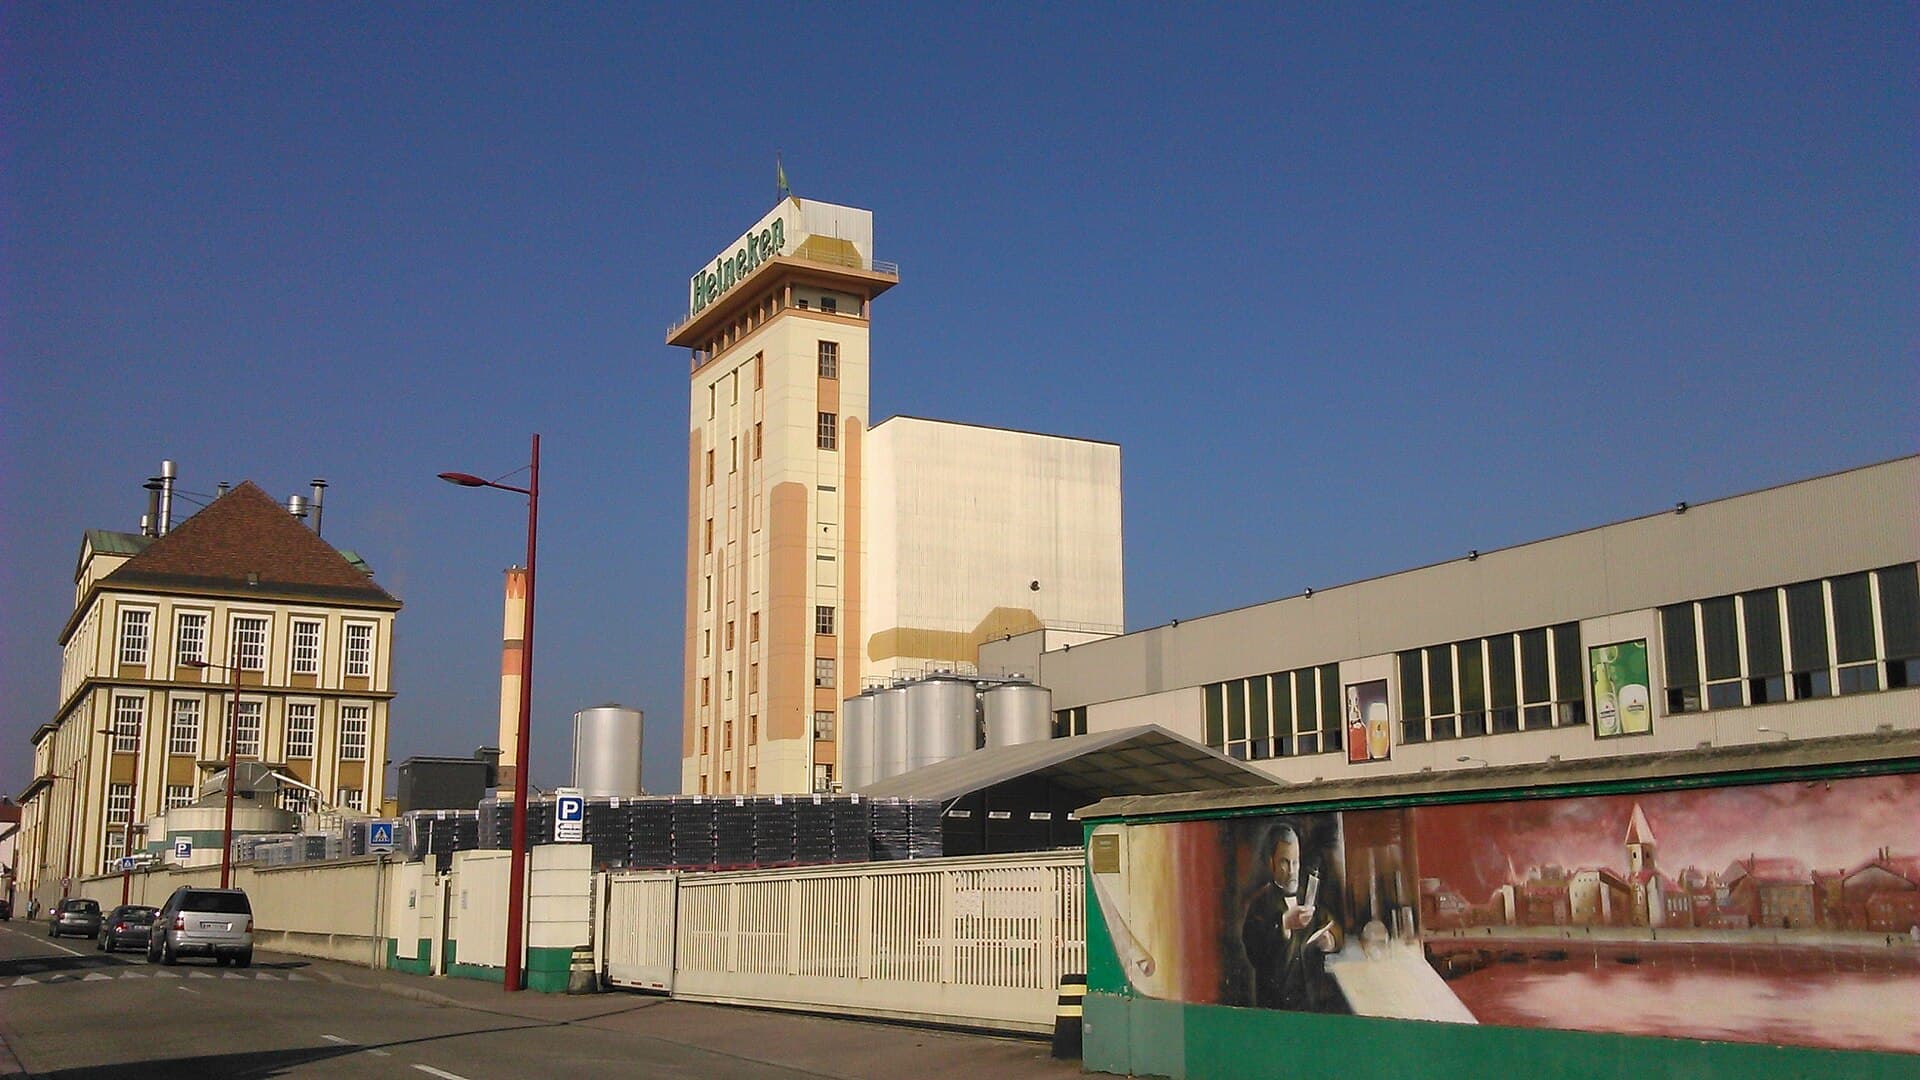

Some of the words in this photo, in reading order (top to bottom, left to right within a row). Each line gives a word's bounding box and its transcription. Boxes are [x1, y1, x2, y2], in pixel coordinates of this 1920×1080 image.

[692, 217, 786, 316] Heineken
[562, 800, 579, 820] P
[177, 843, 187, 854] P
